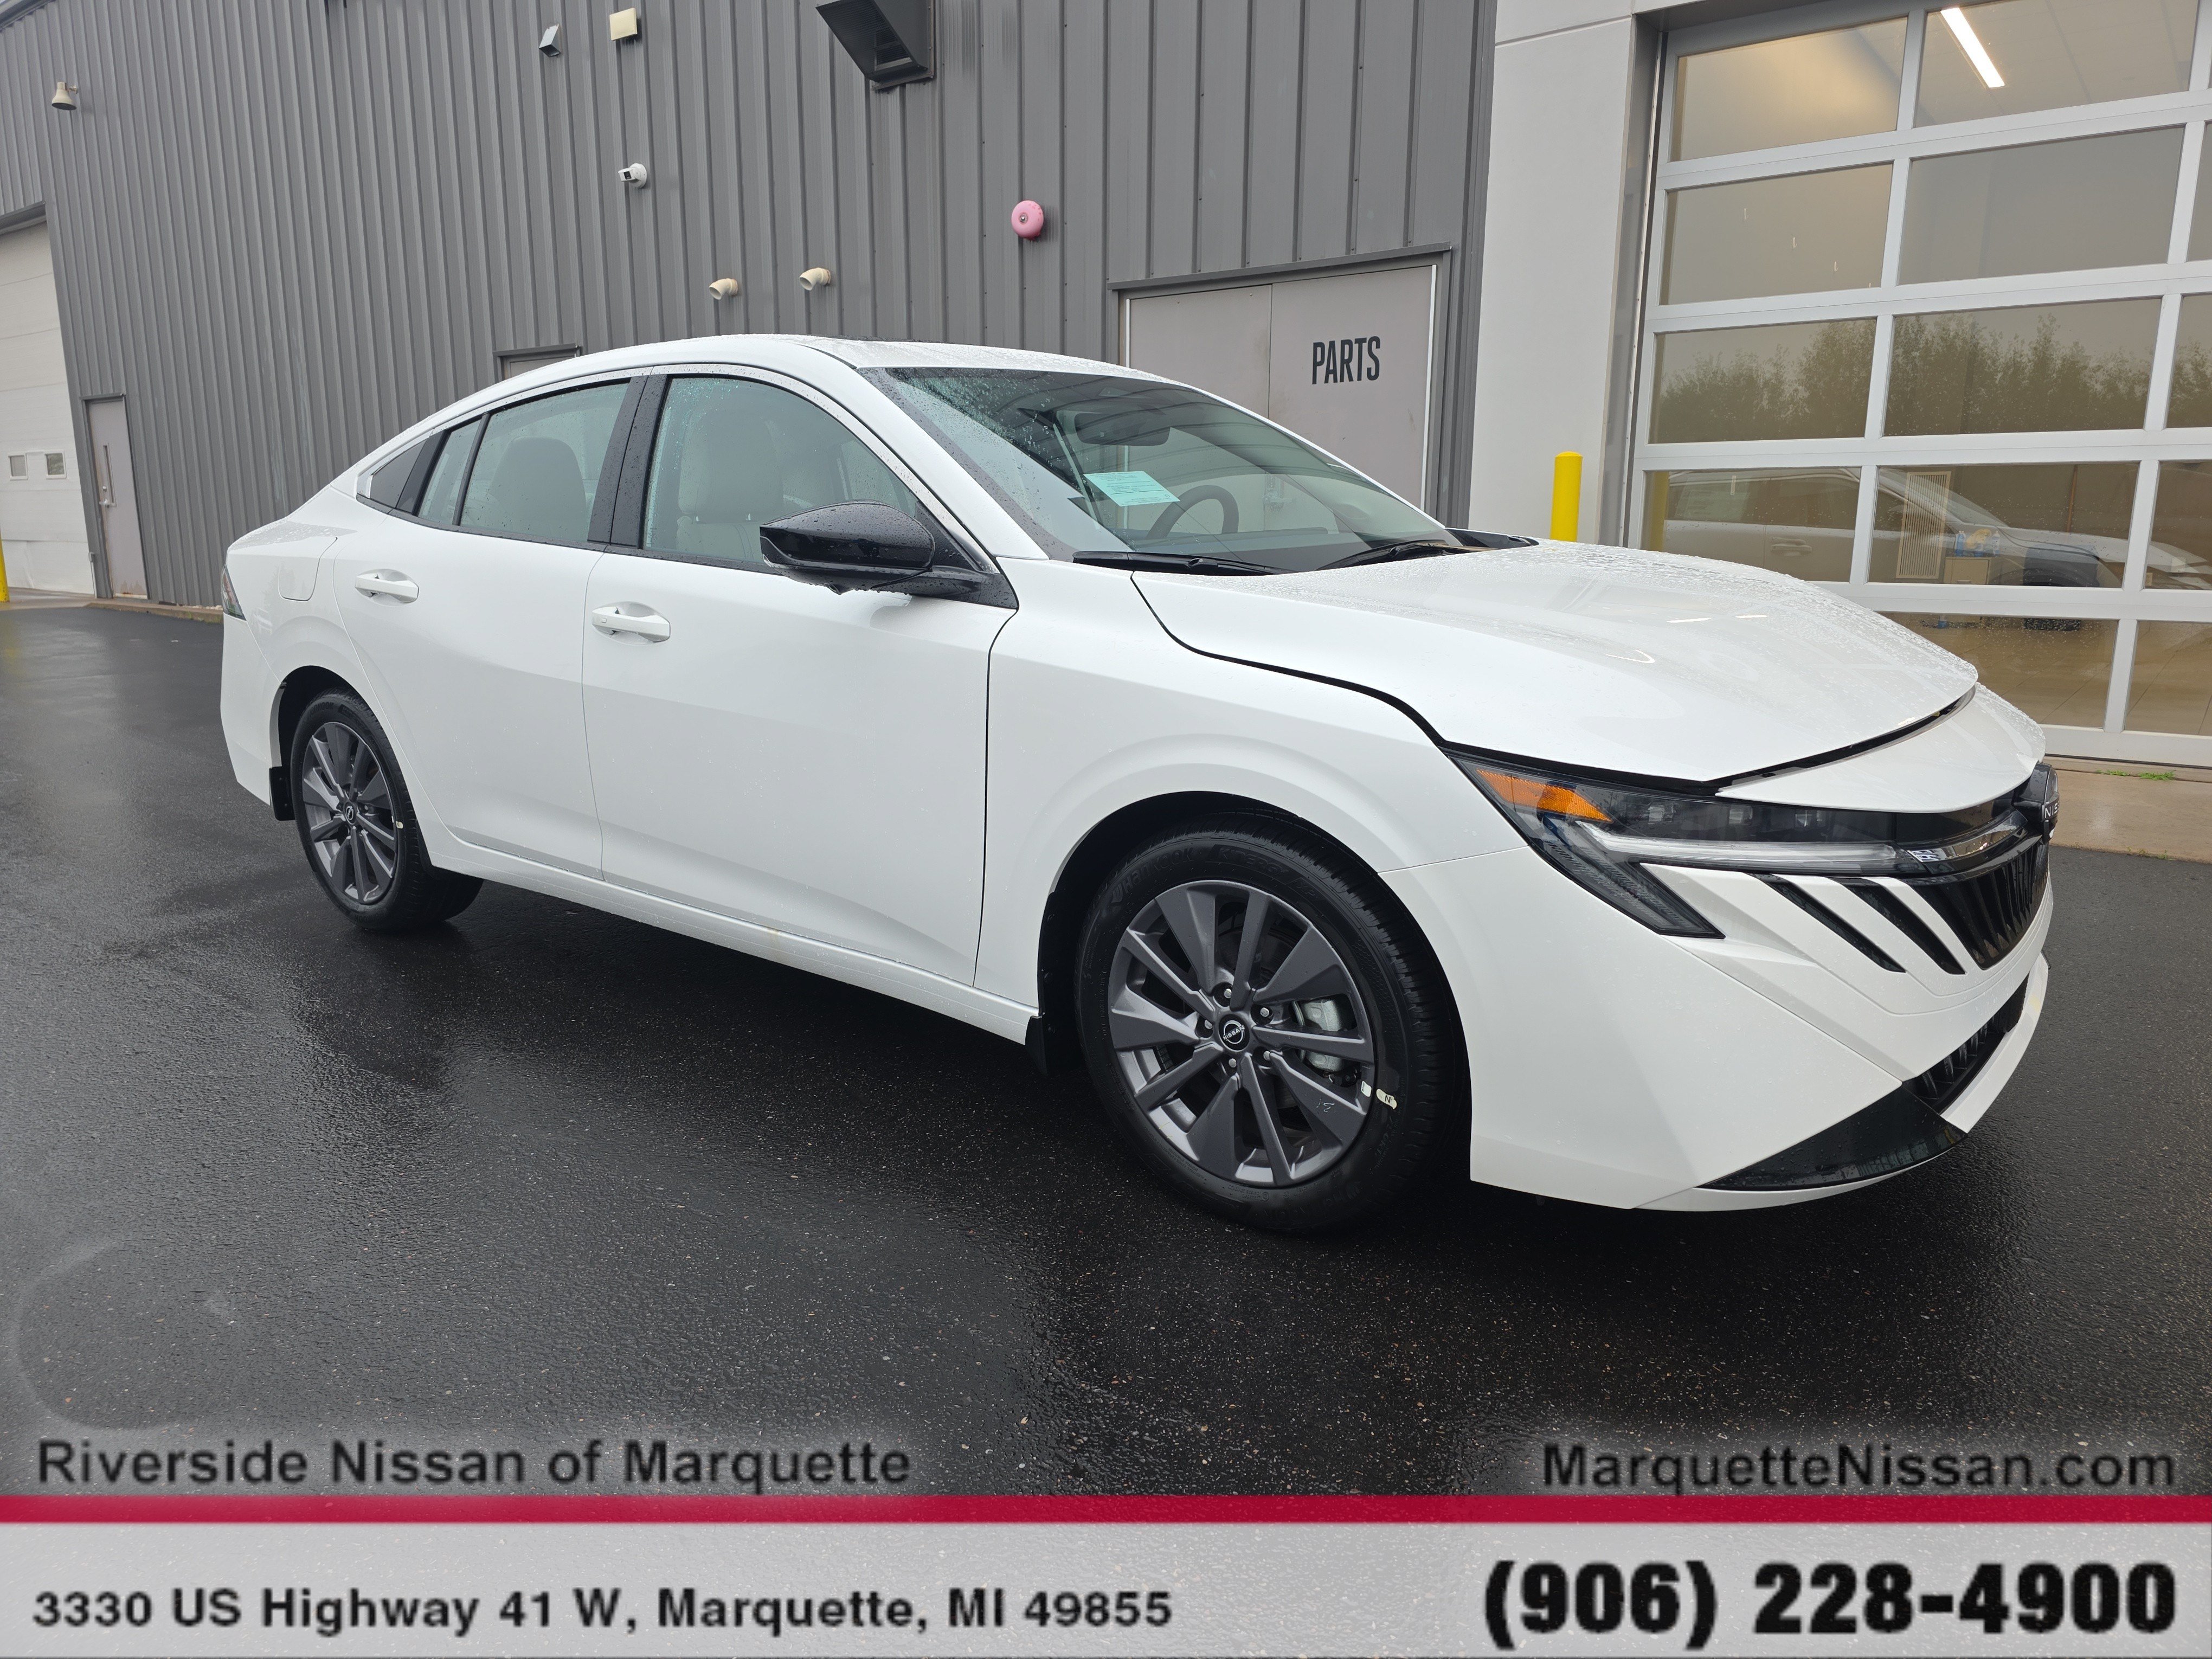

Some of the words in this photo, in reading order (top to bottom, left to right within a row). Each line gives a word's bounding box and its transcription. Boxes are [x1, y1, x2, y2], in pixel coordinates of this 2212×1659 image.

[1312, 336, 1381, 385] PARTS
[2044, 802, 2059, 819] NIS
[1223, 1024, 1245, 1040] NISSAN
